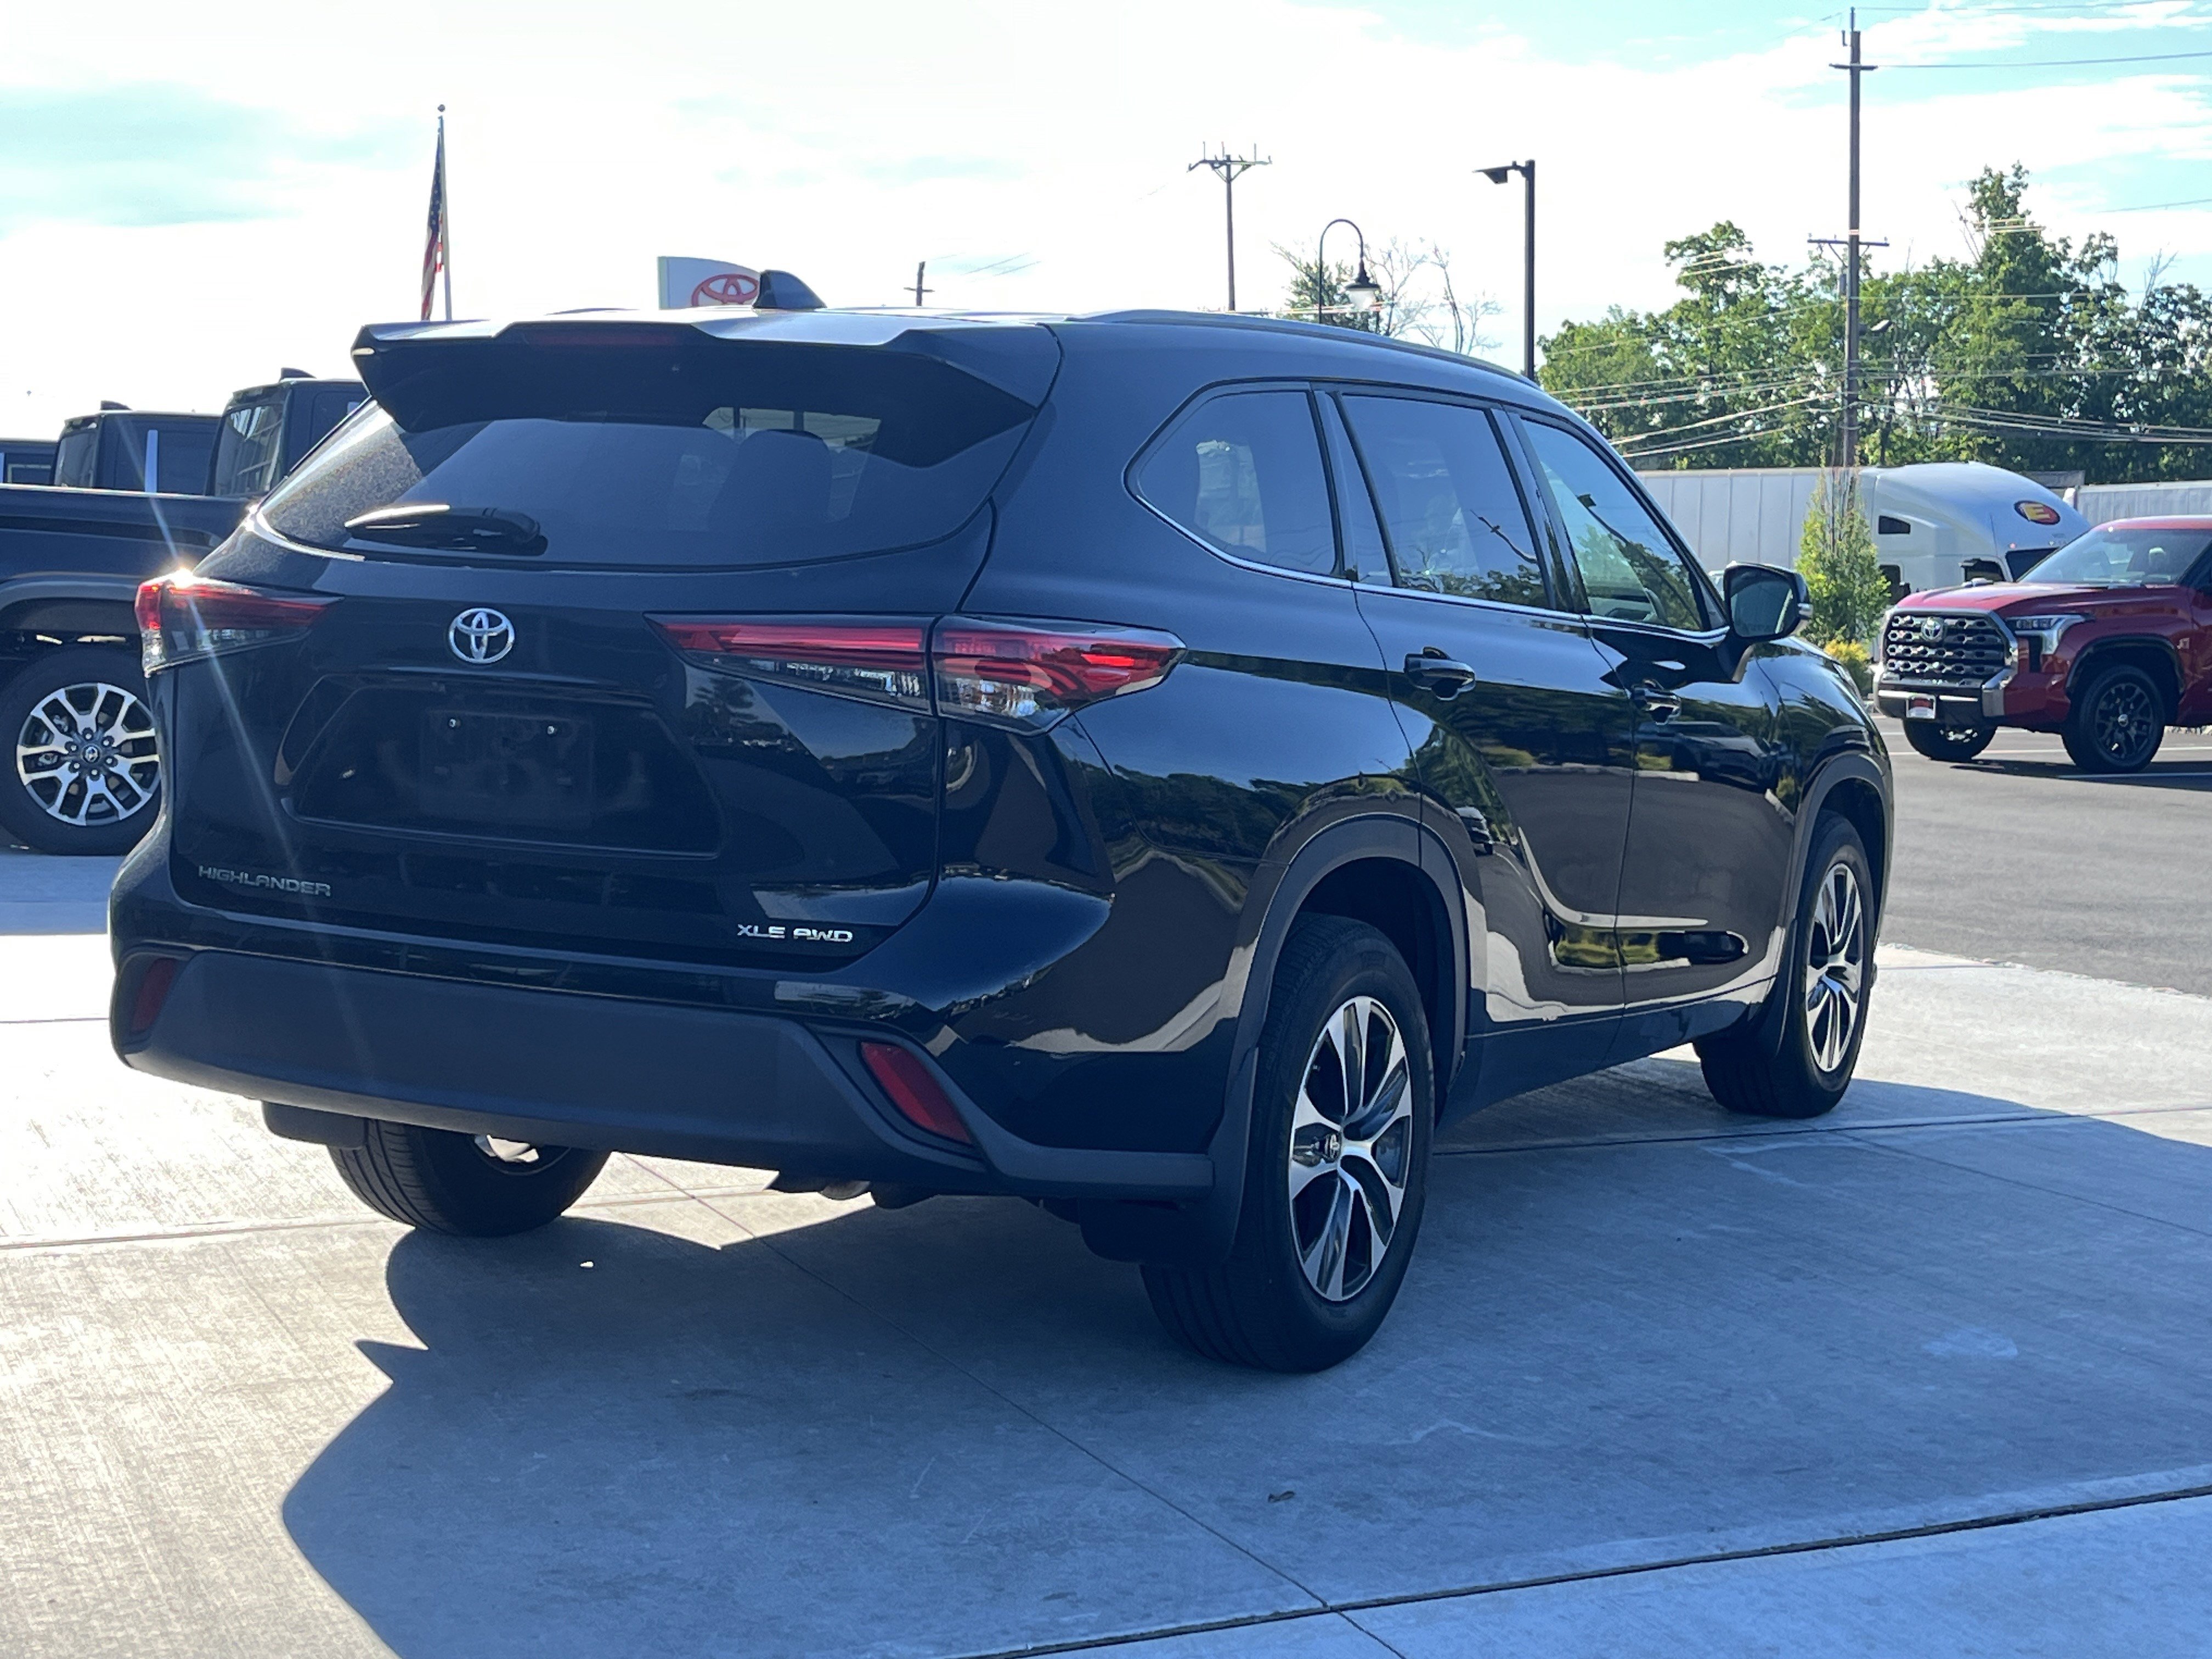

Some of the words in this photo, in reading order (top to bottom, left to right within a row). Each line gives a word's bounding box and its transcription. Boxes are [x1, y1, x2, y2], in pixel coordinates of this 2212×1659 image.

[198, 865, 331, 897] HIGHLANDER
[737, 924, 785, 939] XLE
[793, 928, 853, 943] AWD
